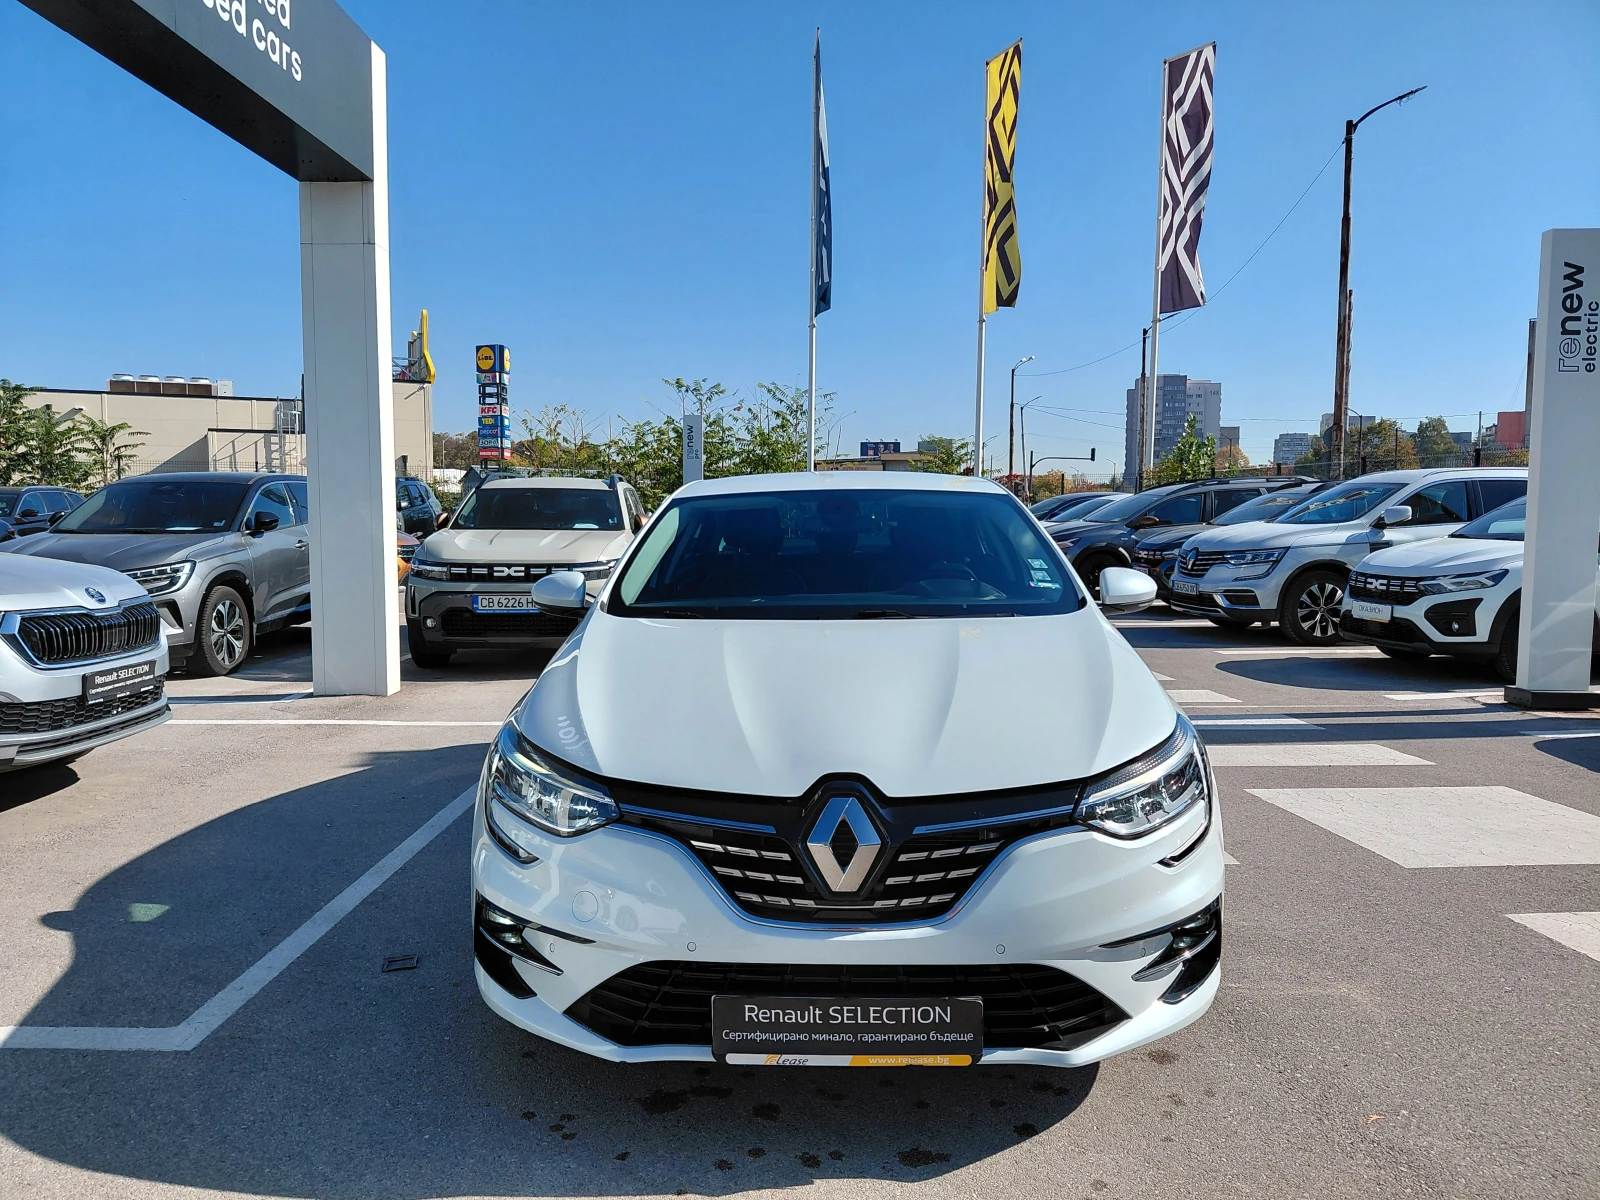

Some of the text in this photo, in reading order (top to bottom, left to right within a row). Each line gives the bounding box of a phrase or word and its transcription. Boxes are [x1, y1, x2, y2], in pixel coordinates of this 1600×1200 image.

[202, 0, 302, 82] ed cars
[1558, 261, 1585, 373] renew
[1582, 300, 1600, 373] electric
[480, 597, 537, 608] CB 6226 H
[95, 664, 150, 684] Renault SELECTION
[744, 1004, 951, 1024] Renault SELECTION
[722, 1029, 974, 1044] Сертифицирано минало, гарантирано бъдеще
